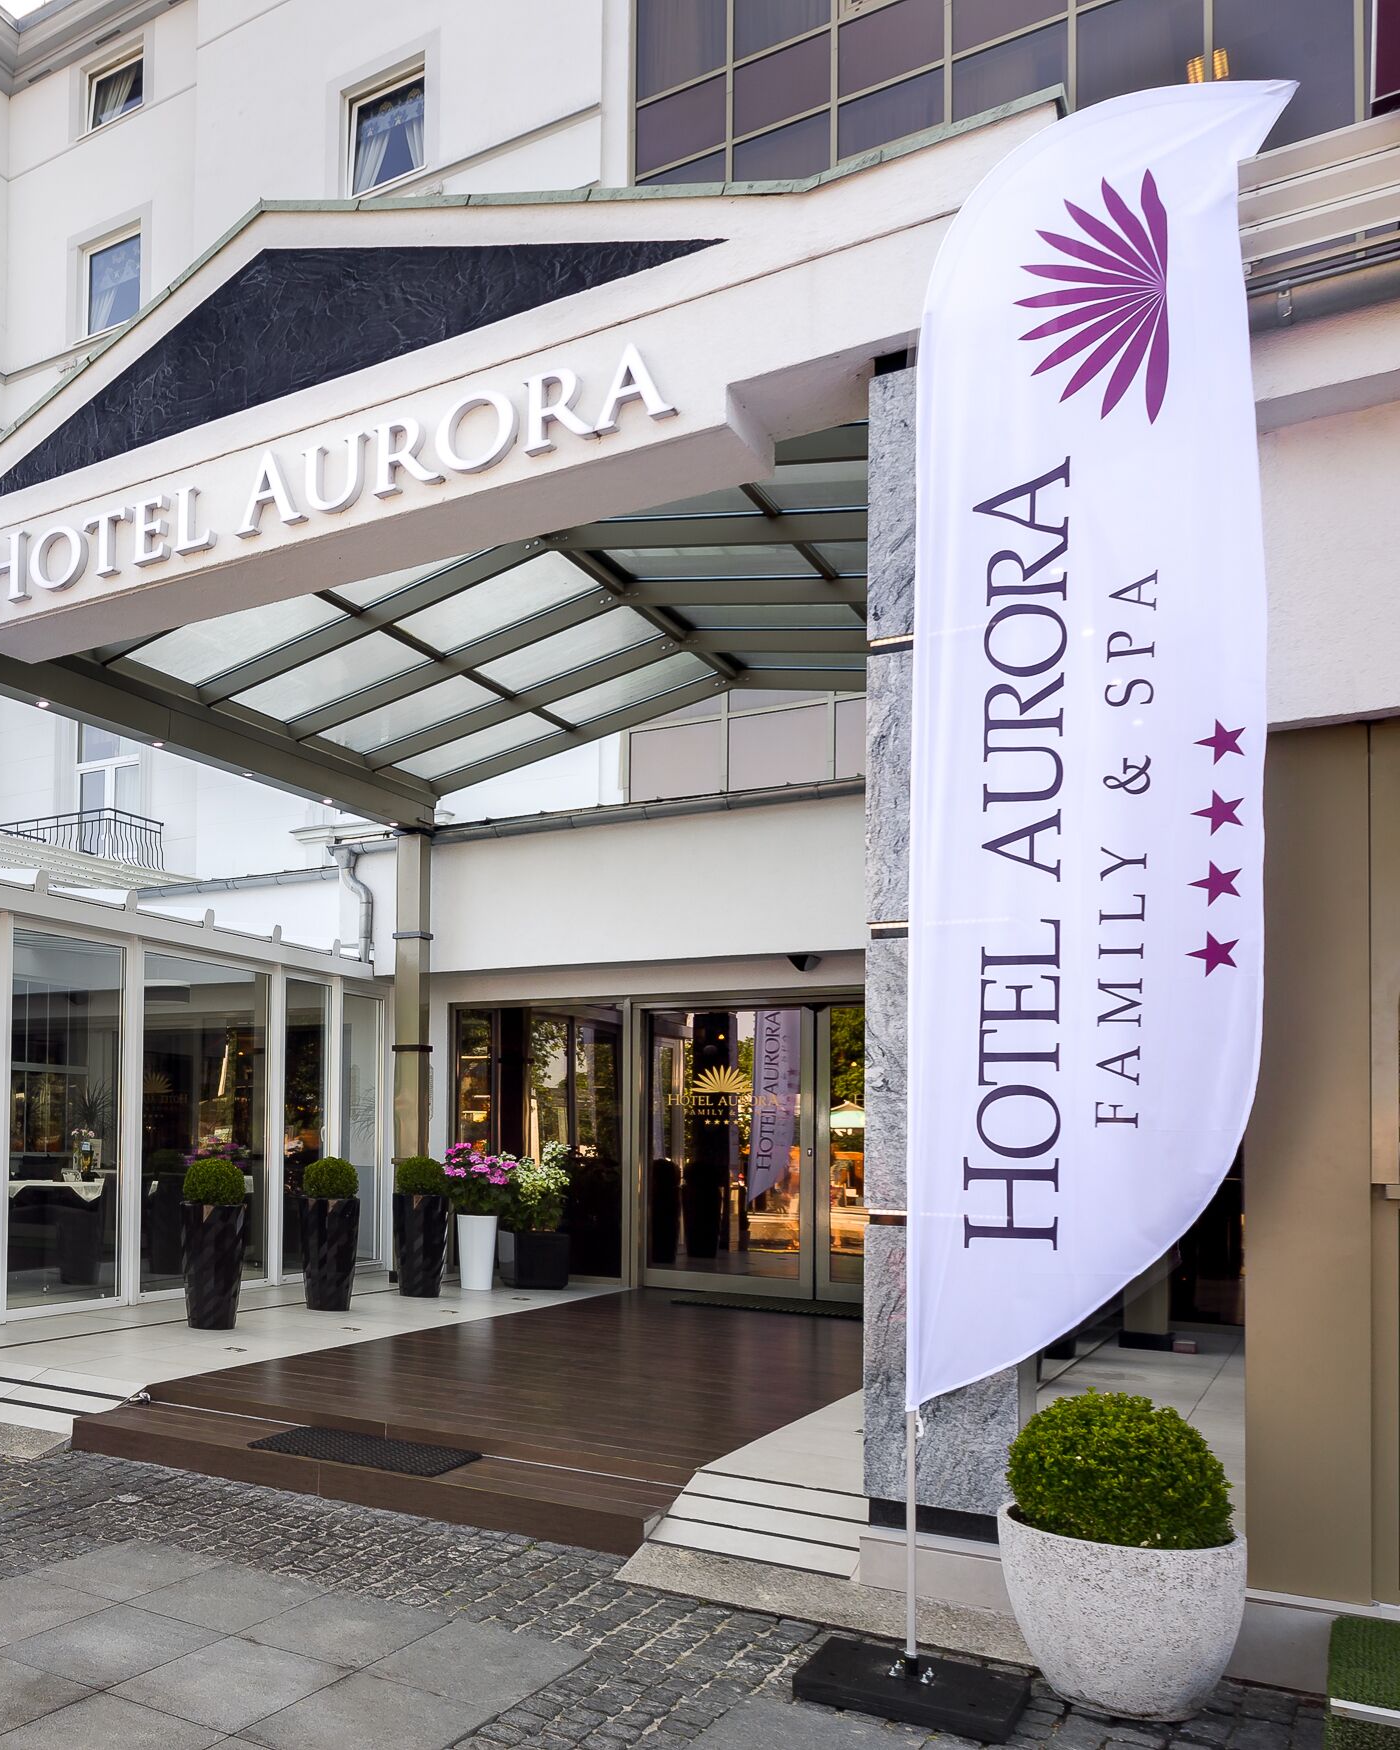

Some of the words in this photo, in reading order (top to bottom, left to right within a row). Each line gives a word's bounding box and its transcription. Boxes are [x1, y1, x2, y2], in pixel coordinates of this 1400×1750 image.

[235, 343, 679, 539] AURORA
[972, 455, 1071, 882] AURORA
[1104, 569, 1159, 708] SPA
[1102, 754, 1152, 795] &
[963, 919, 1061, 1251] HOTEL
[1094, 847, 1147, 1129] FAMILY
[667, 1094, 713, 1106] HOTEL
